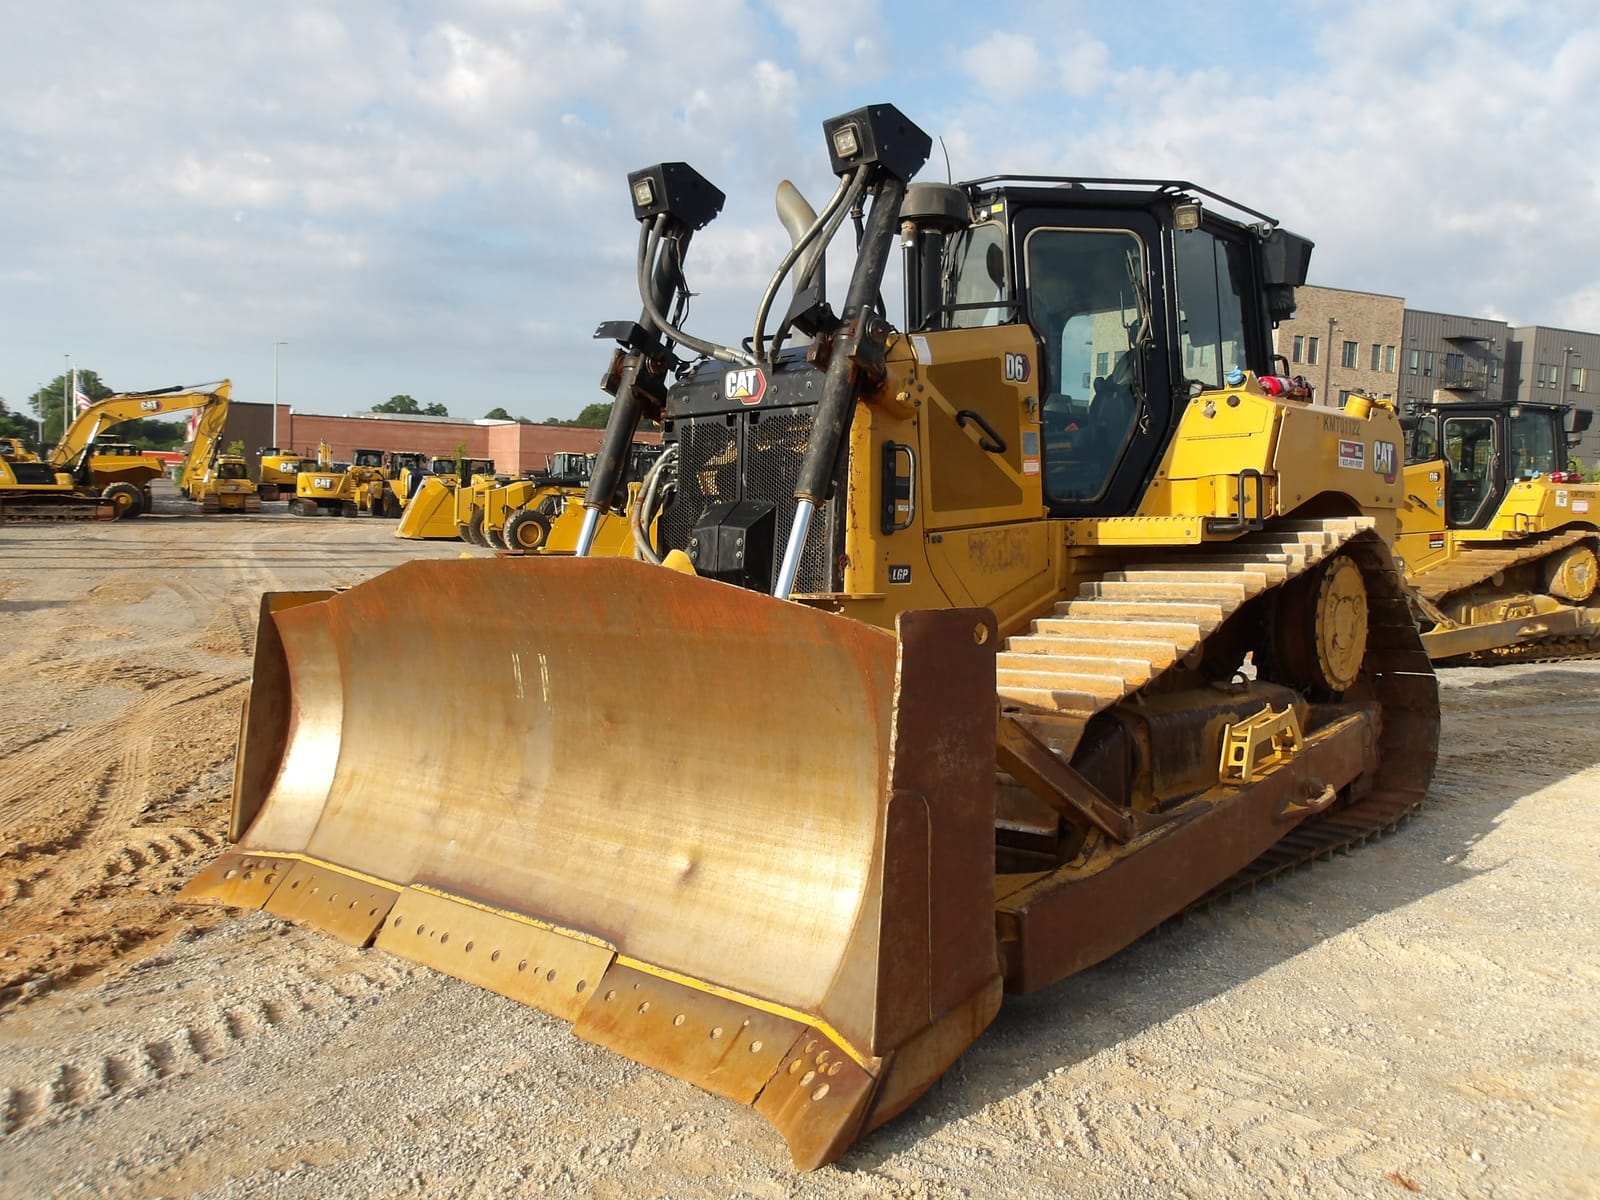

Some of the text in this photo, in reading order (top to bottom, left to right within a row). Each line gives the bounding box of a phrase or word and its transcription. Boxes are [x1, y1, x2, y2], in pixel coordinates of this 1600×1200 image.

[1006, 354, 1024, 381] D6
[726, 370, 756, 398] CAT
[141, 400, 157, 411] CAT
[1323, 416, 1361, 436] KMT01122
[1374, 441, 1393, 473] CAT
[280, 462, 297, 473] CA
[314, 478, 331, 489] CAT
[892, 568, 909, 581] LGP
